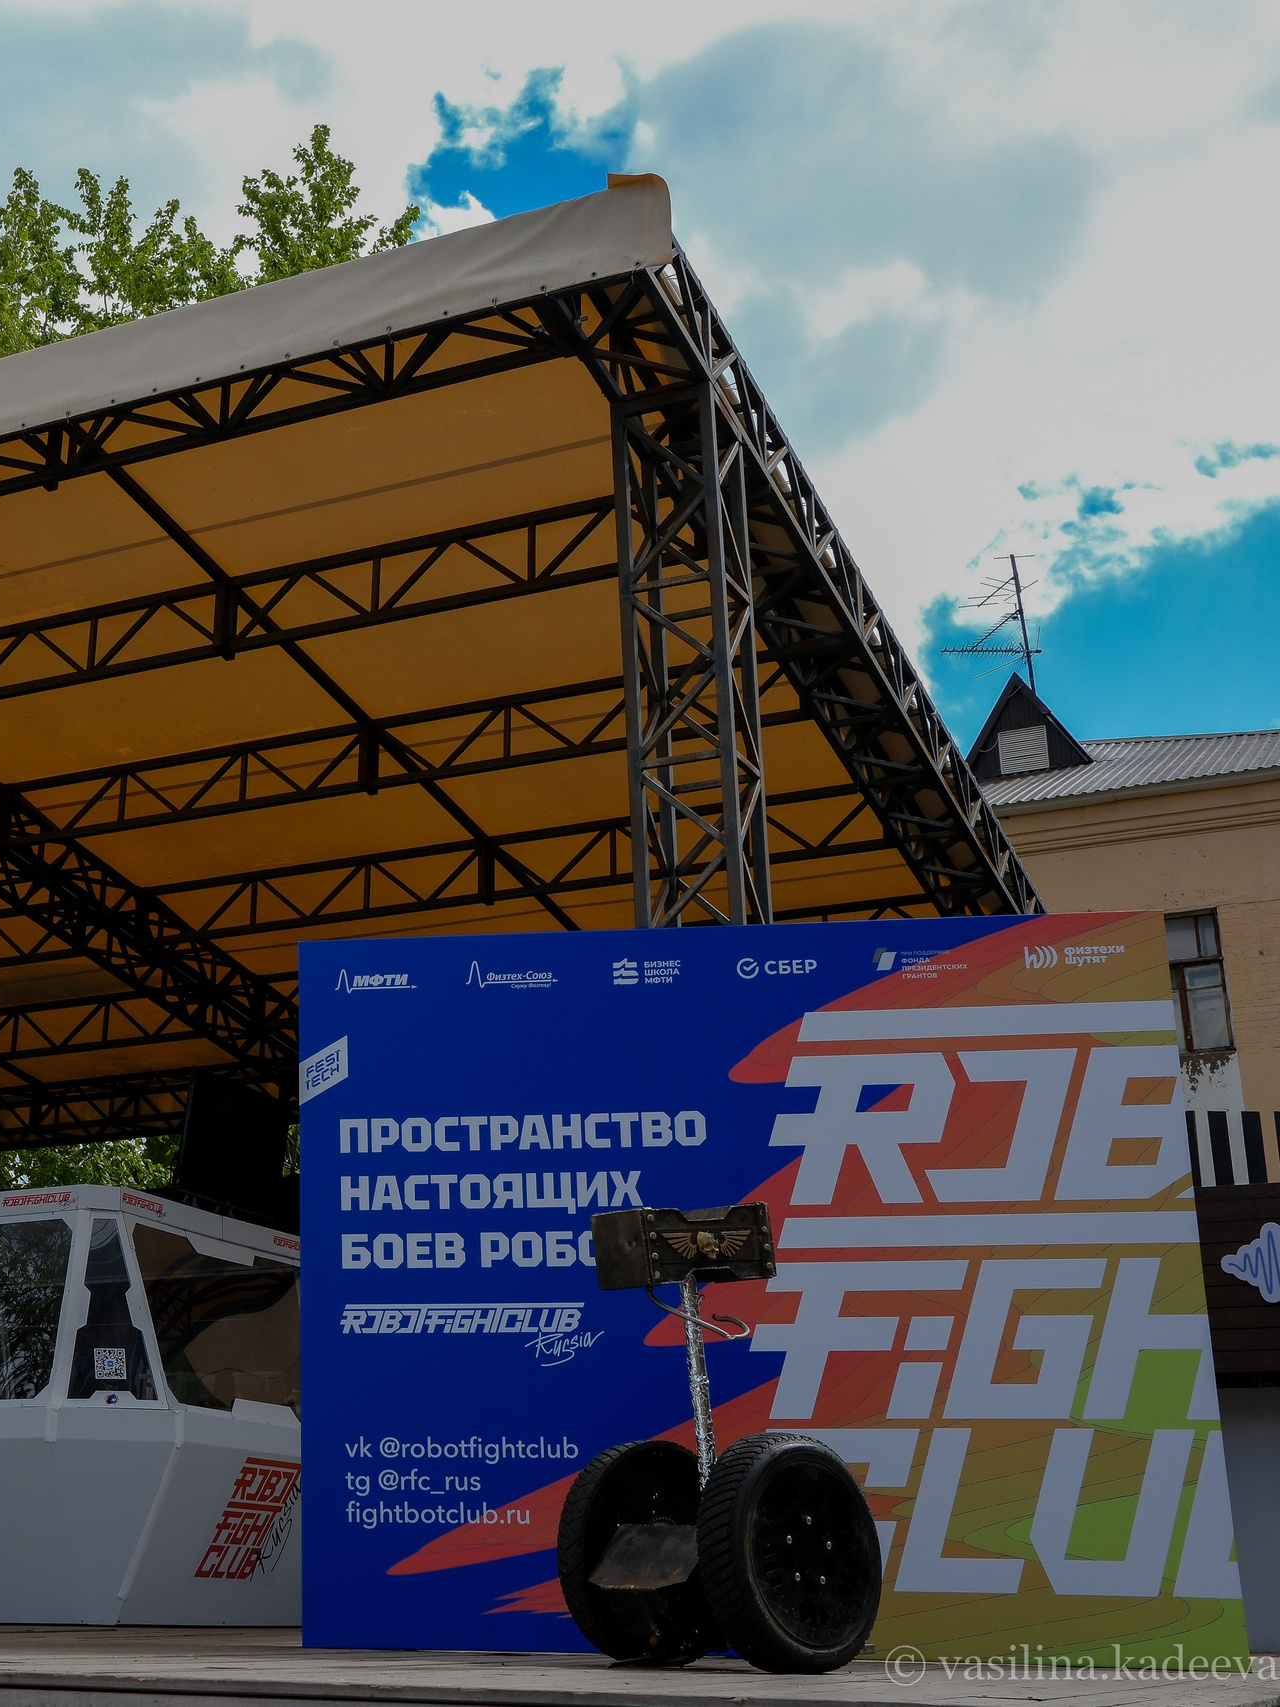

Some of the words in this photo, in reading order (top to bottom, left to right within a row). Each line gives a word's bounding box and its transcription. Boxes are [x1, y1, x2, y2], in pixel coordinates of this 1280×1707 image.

[486, 970, 553, 981] Физтех-Союз
[643, 960, 681, 968] БИЗНЕС
[644, 968, 680, 976] ШКОЛА
[764, 959, 818, 975] СБЕР
[902, 963, 968, 972] ПРЕЗИДЕНТСКИХ
[353, 974, 409, 987] МФТИ
[644, 976, 673, 984] МФТИ
[304, 1063, 339, 1091] TECH
[306, 1049, 340, 1078] FEST
[339, 1110, 707, 1154] ПРОСТРАНСТВО
[340, 1171, 643, 1215] НАСТОЯЩИХ
[341, 1232, 466, 1269] БОЕВ
[525, 1331, 605, 1366] Russia
[345, 1436, 372, 1458] vk
[379, 1436, 579, 1464] @robotfightclub
[345, 1472, 370, 1496] tg
[378, 1468, 482, 1495] @rfc_rus
[346, 1501, 530, 1530] fightbotclub.ru
[194, 1545, 261, 1579] CLUB
